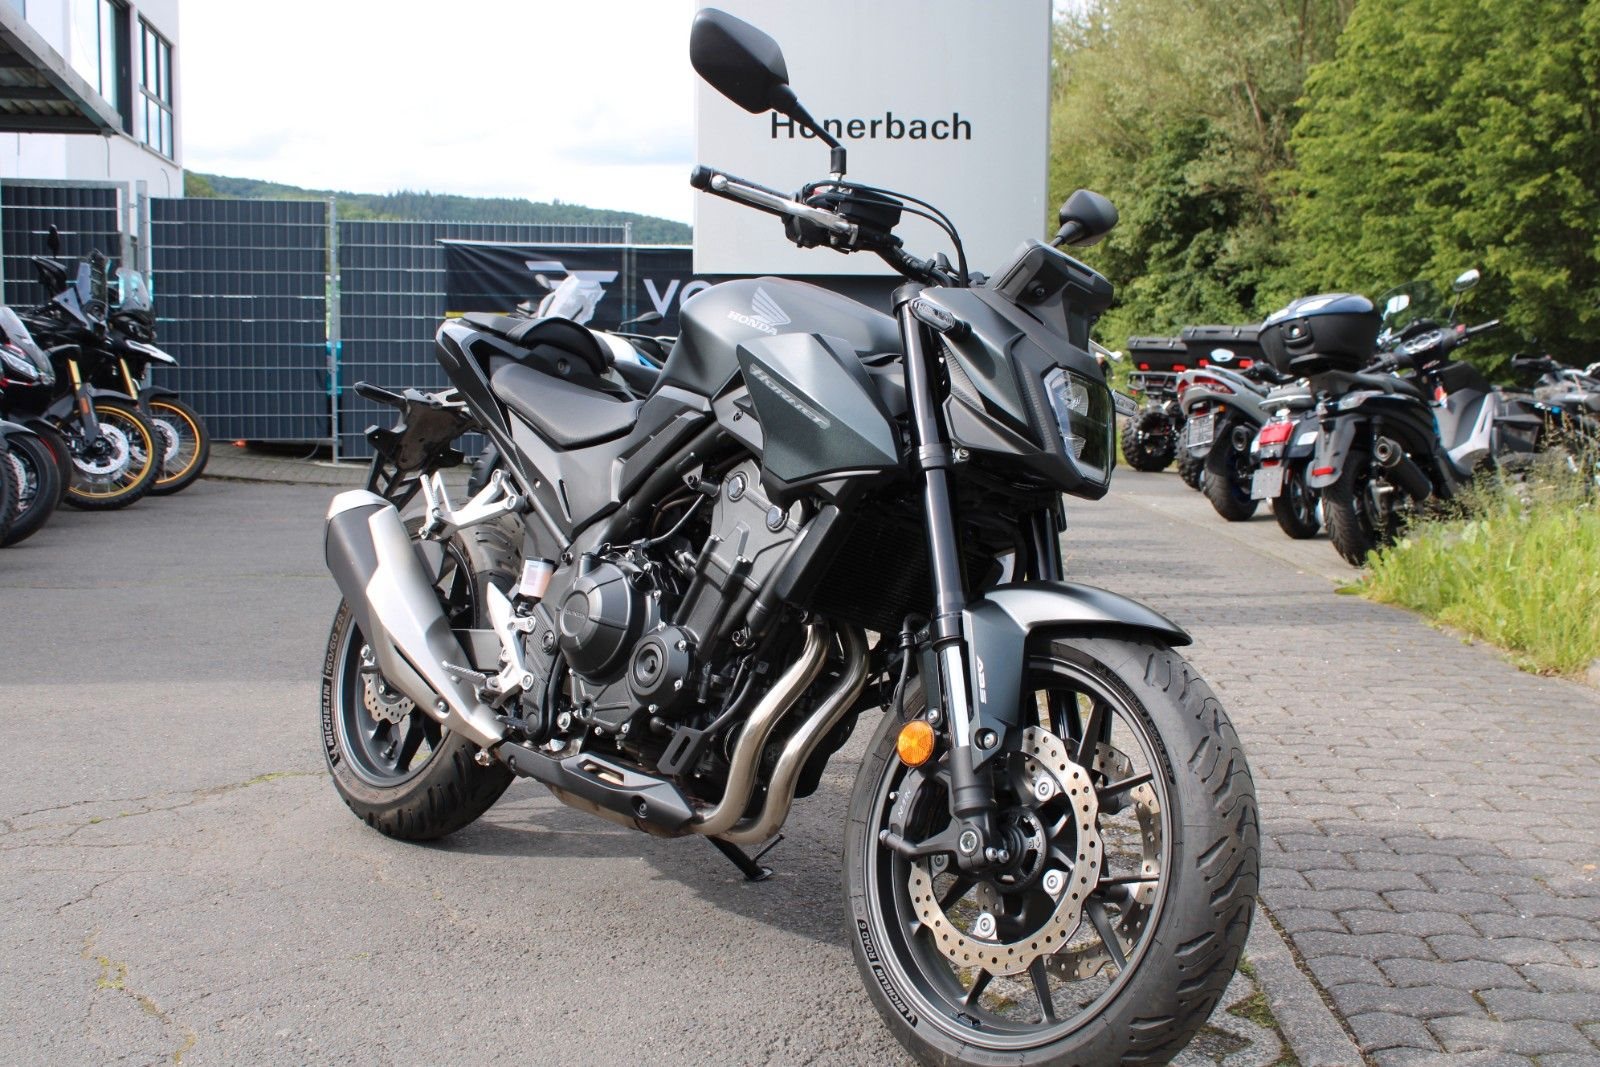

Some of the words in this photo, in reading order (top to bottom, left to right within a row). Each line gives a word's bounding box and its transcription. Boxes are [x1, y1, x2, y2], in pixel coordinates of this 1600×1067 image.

[728, 310, 778, 336] HONDA
[325, 633, 338, 675] 160/60
[323, 684, 335, 747] MICHELIN
[861, 932, 877, 960] ROAD
[875, 968, 907, 1012] MICHELIN
